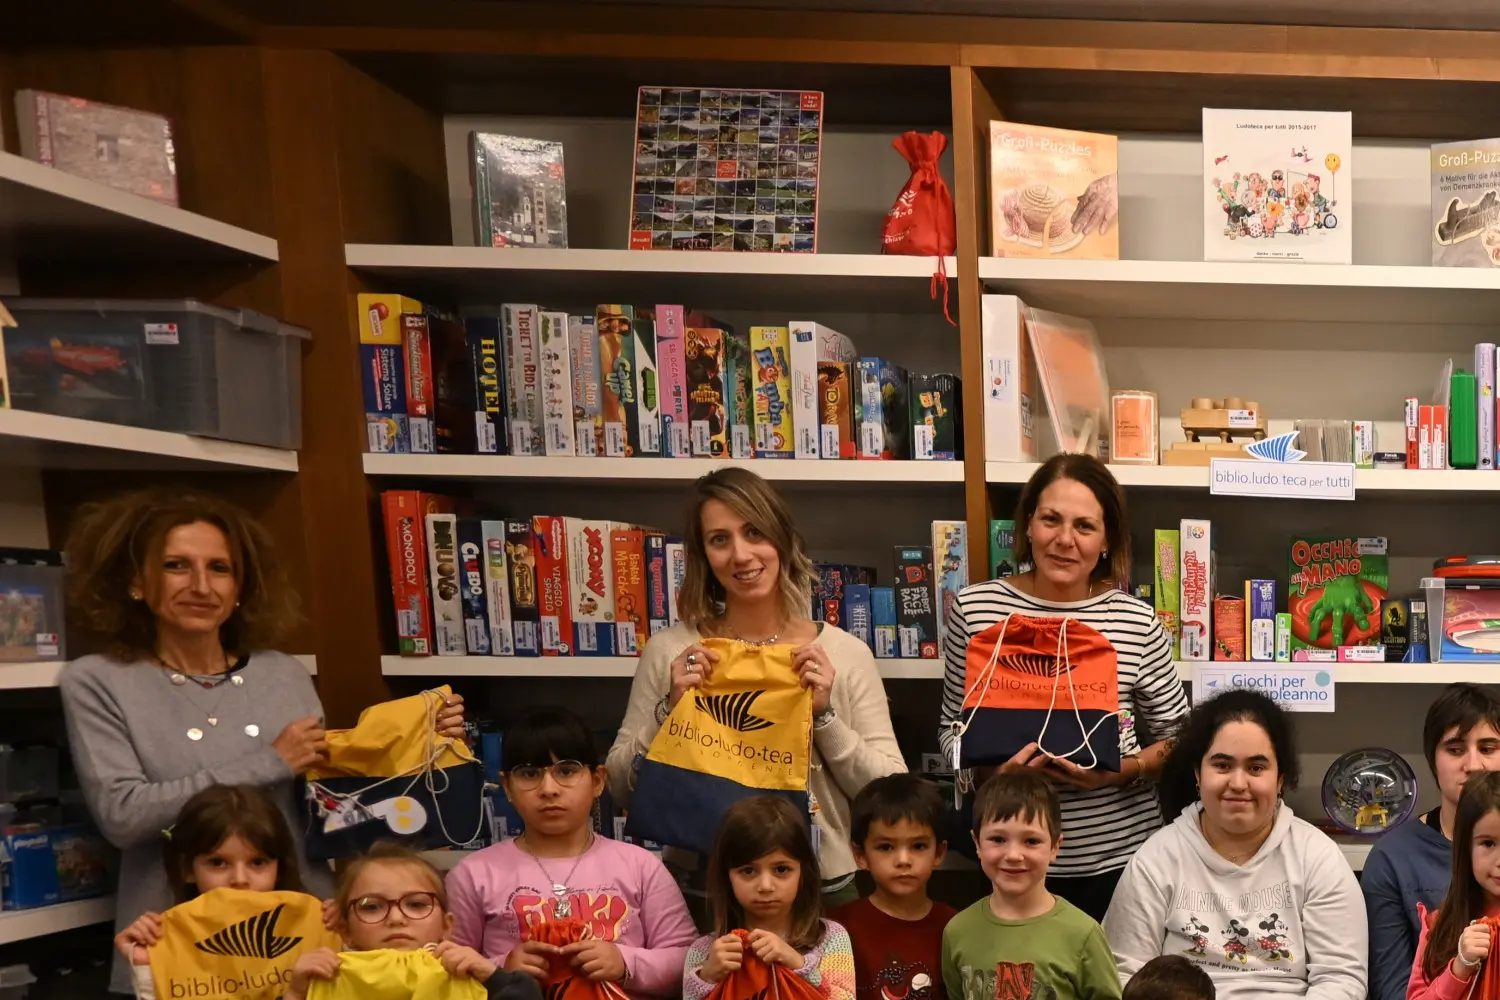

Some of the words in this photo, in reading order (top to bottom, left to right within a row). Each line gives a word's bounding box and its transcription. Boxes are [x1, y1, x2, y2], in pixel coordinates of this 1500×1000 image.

[380, 348, 391, 380] Sistema
[481, 338, 500, 422] HOTEL
[382, 382, 393, 410] Solare
[1309, 478, 1323, 488] per
[1326, 476, 1351, 488] tutti
[401, 525, 417, 586] MONOPOLY
[461, 542, 483, 596] CLUEDO
[543, 577, 554, 612] SPAZIO
[552, 566, 563, 607] VIAGGIO
[901, 587, 913, 616] RACE
[911, 587, 923, 616] FACE
[919, 586, 931, 614] ROBOT
[1231, 674, 1277, 688] Giochi
[1281, 676, 1306, 691] per
